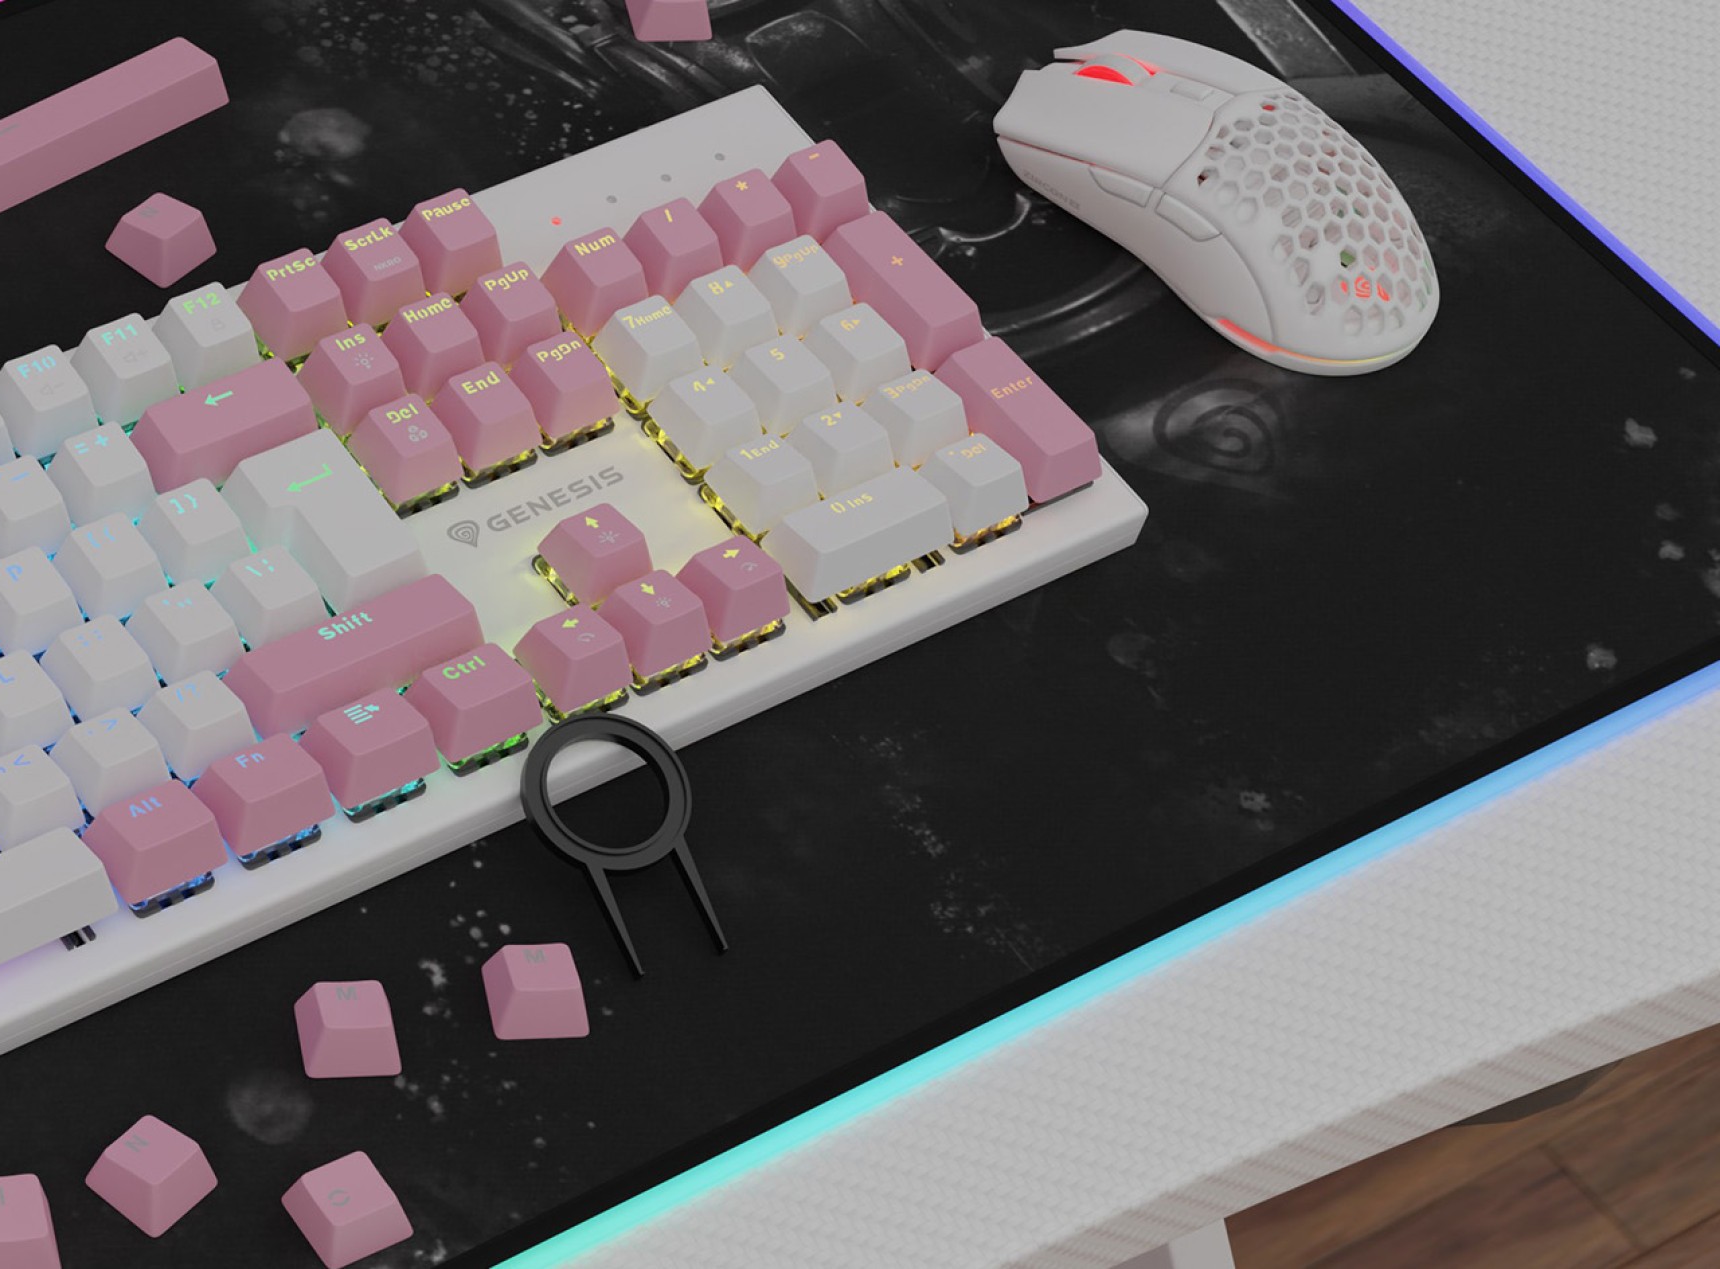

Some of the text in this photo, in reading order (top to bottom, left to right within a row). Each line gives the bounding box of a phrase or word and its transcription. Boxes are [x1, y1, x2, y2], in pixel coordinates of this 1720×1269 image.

[420, 196, 473, 222] Pause
[343, 224, 395, 253] ScrLk
[574, 231, 617, 257] Num
[266, 254, 318, 284] PrtSc
[483, 266, 531, 294] PgUp
[182, 292, 222, 316] F12
[401, 296, 457, 325] Home
[102, 324, 139, 347] F11
[334, 330, 368, 353] Ins
[535, 337, 583, 366] PgDn
[769, 348, 786, 362] 5
[17, 355, 58, 380] F10
[461, 370, 502, 395] End
[990, 375, 1035, 400] Enter
[385, 402, 420, 426] Del
[486, 464, 626, 533] GENESIS
[5, 563, 24, 582] P
[318, 611, 374, 641] Shift
[441, 655, 489, 682] Ctrl
[235, 750, 266, 770] Fn
[128, 795, 164, 819] Alt
[522, 948, 548, 964] M
[335, 986, 359, 1001] M
